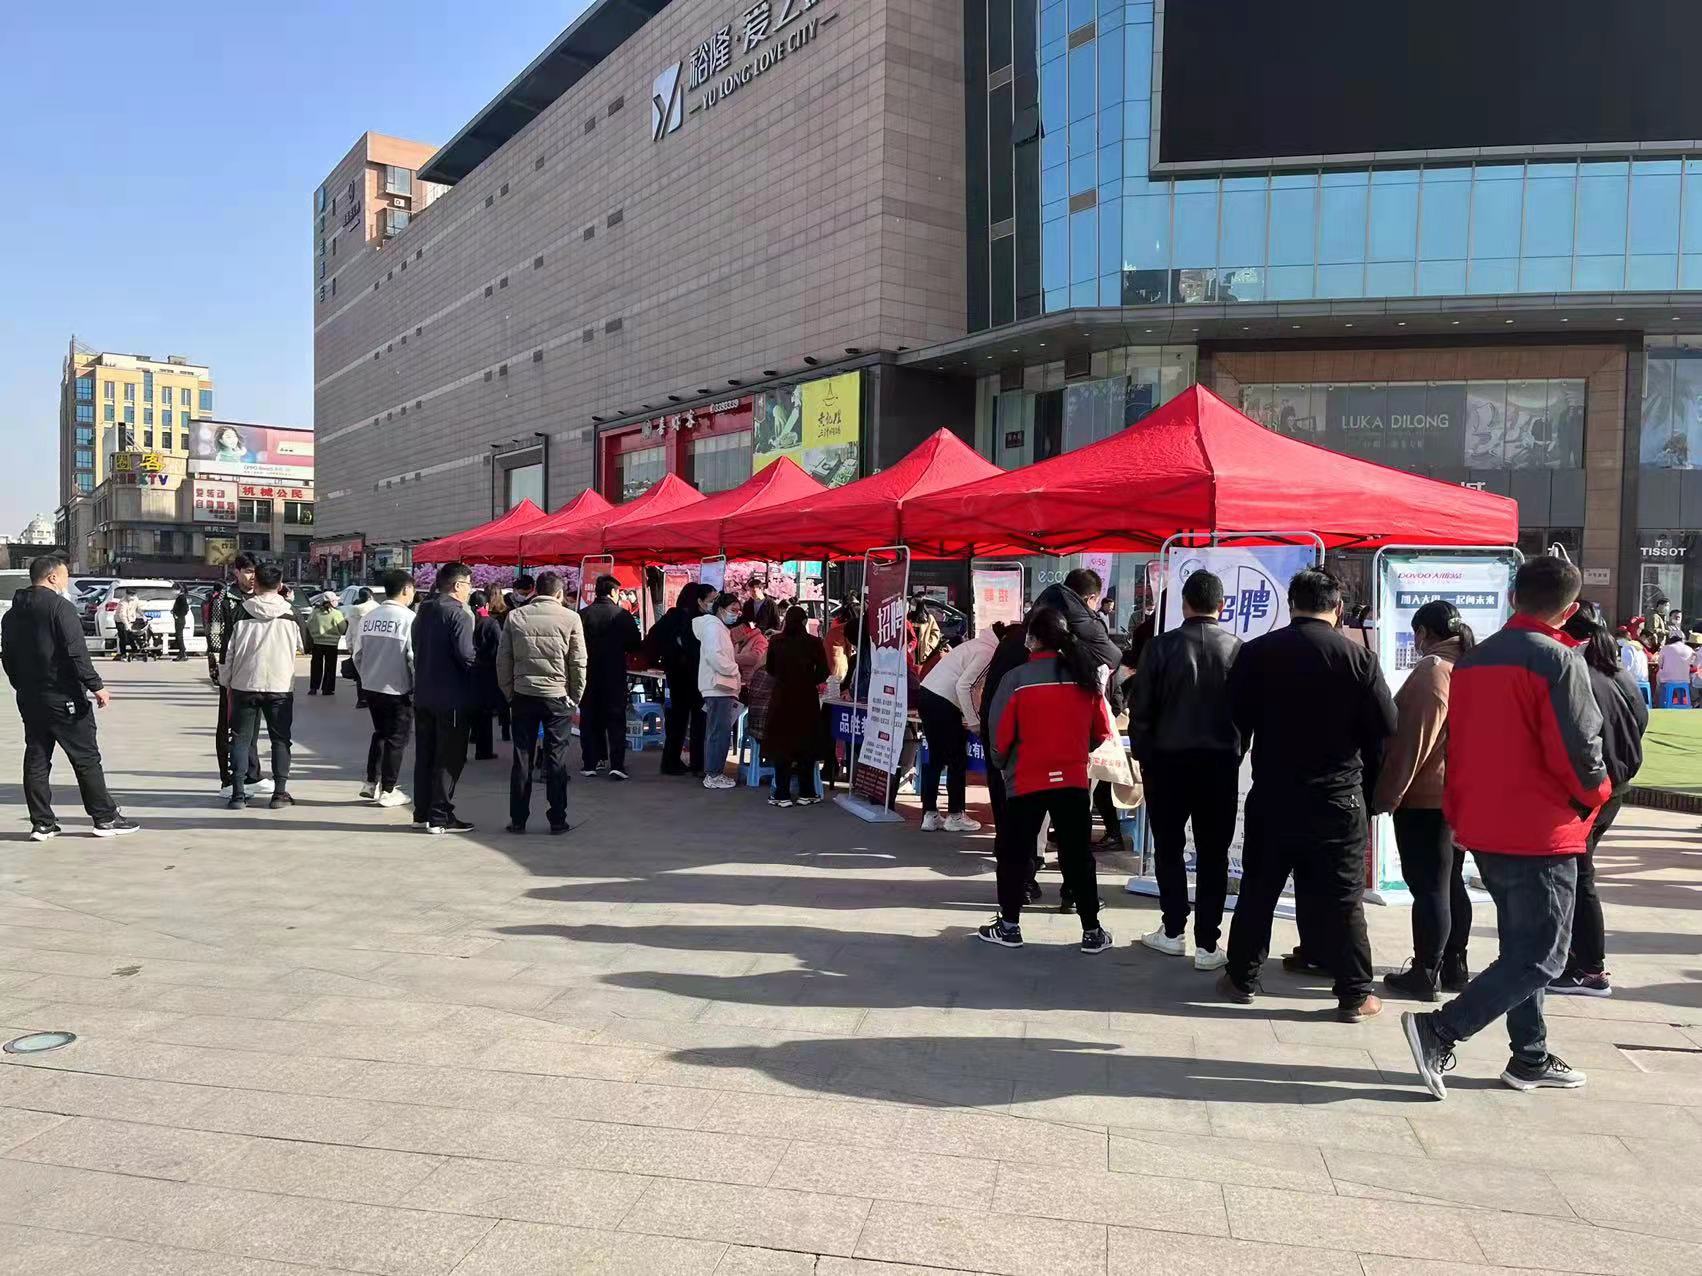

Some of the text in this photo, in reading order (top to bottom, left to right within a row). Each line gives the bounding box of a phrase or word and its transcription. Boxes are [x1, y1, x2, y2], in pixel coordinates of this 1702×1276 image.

[689, 0, 820, 91] 裕隆·爱之
[702, 18, 818, 110] YU LONG LOVE CITY
[1342, 414, 1449, 429] LUKA DILONG
[242, 486, 303, 498] 机械公民
[1640, 548, 1686, 556] TISSOT
